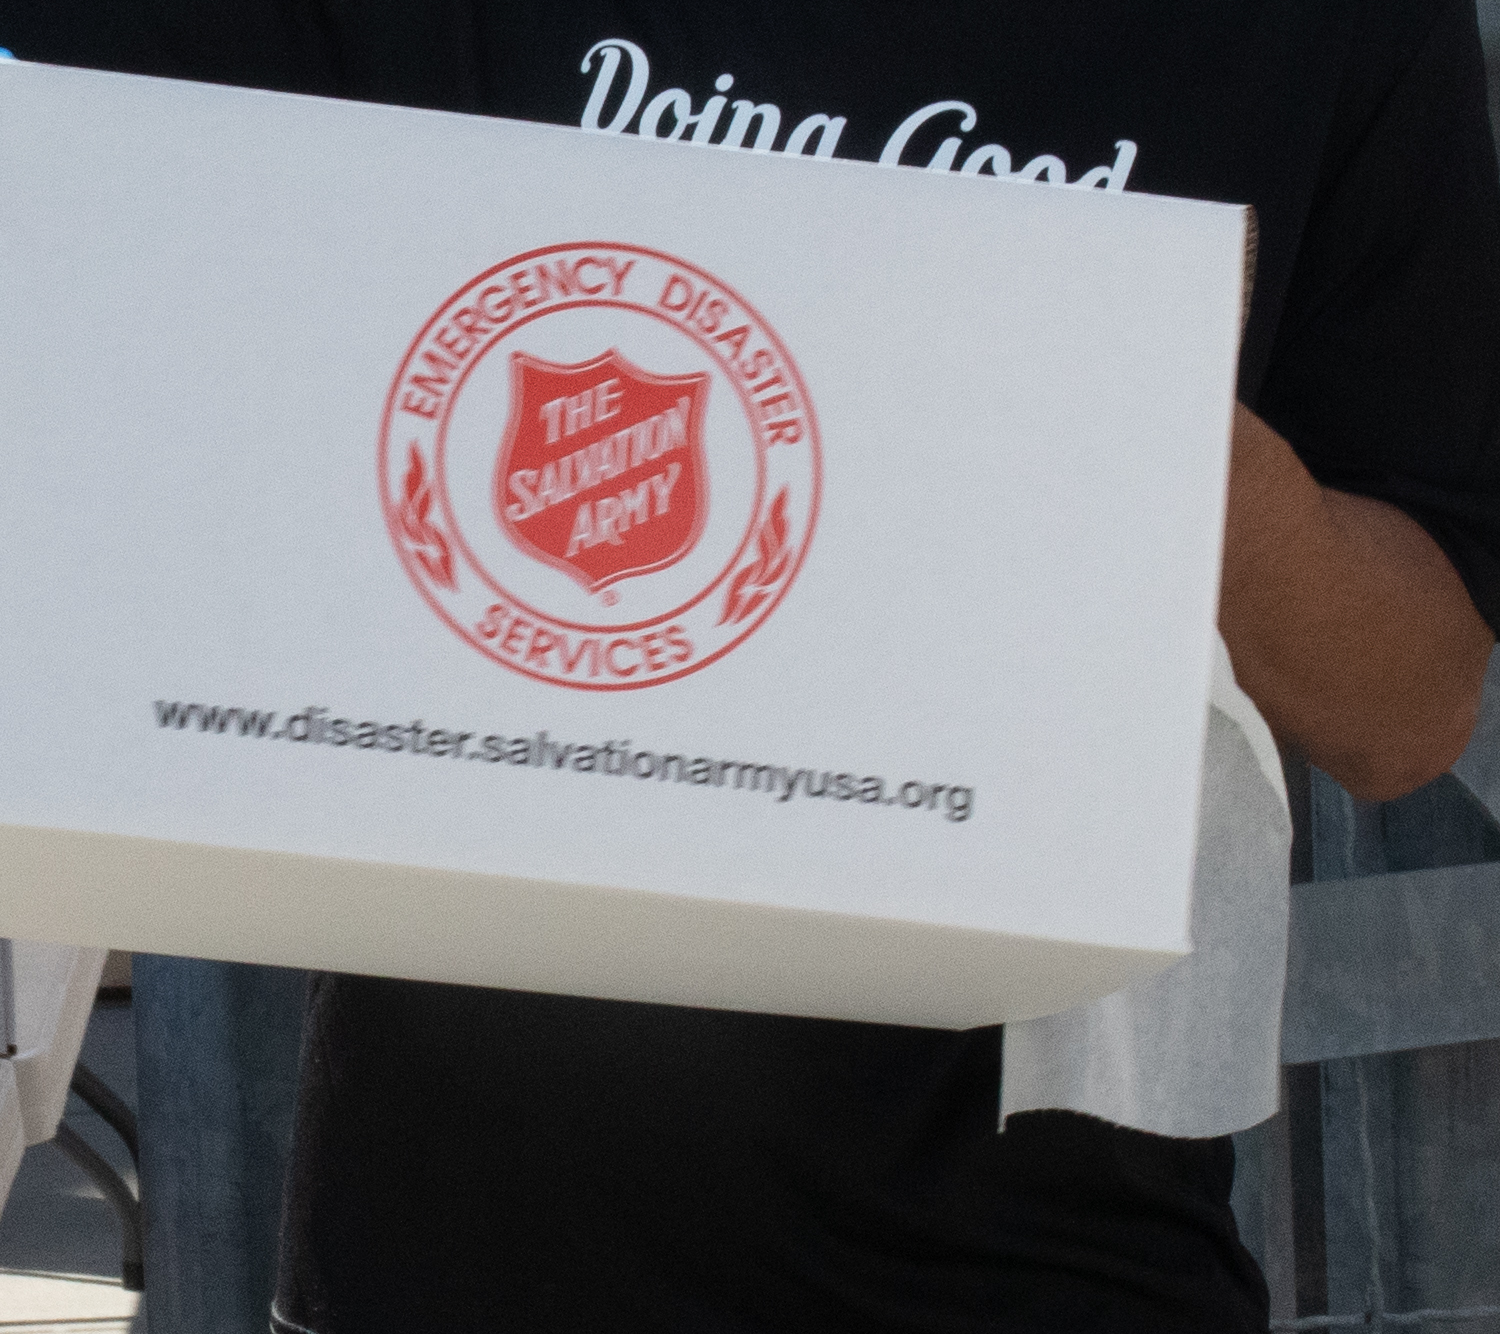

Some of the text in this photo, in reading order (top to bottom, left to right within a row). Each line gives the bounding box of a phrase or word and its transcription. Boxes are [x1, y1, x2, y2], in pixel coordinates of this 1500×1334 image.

[401, 256, 804, 448] EMERGENCY DISASTER
[504, 395, 692, 522] SALVATION
[538, 376, 625, 445] THE
[565, 462, 684, 559] ARMY
[476, 603, 695, 680] SERVICES
[153, 692, 976, 823] www.disaster.salvationarmyusa.org
